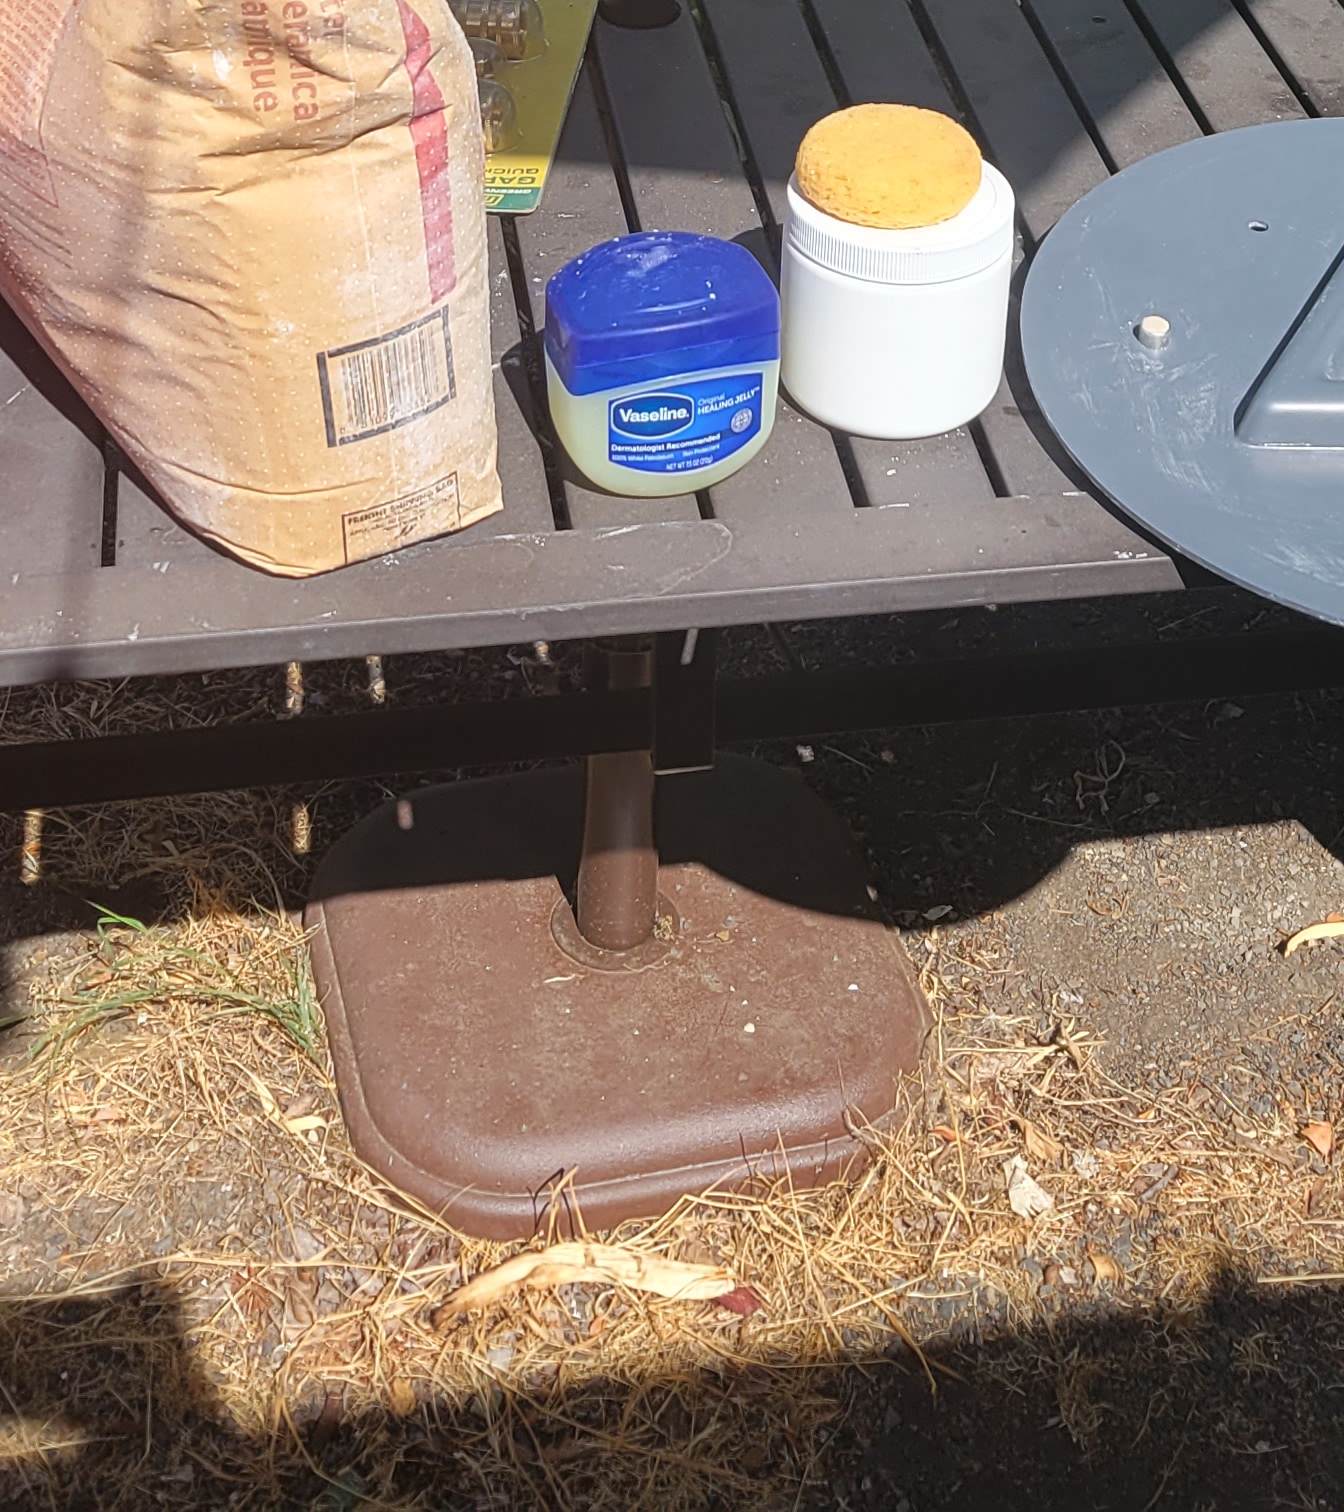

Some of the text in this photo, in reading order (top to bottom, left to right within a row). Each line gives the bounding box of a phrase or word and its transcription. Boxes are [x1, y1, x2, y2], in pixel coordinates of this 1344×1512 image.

[698, 393, 725, 406] Original
[698, 399, 734, 415] HEALING
[611, 433, 721, 452] Dermatologist Recommended
